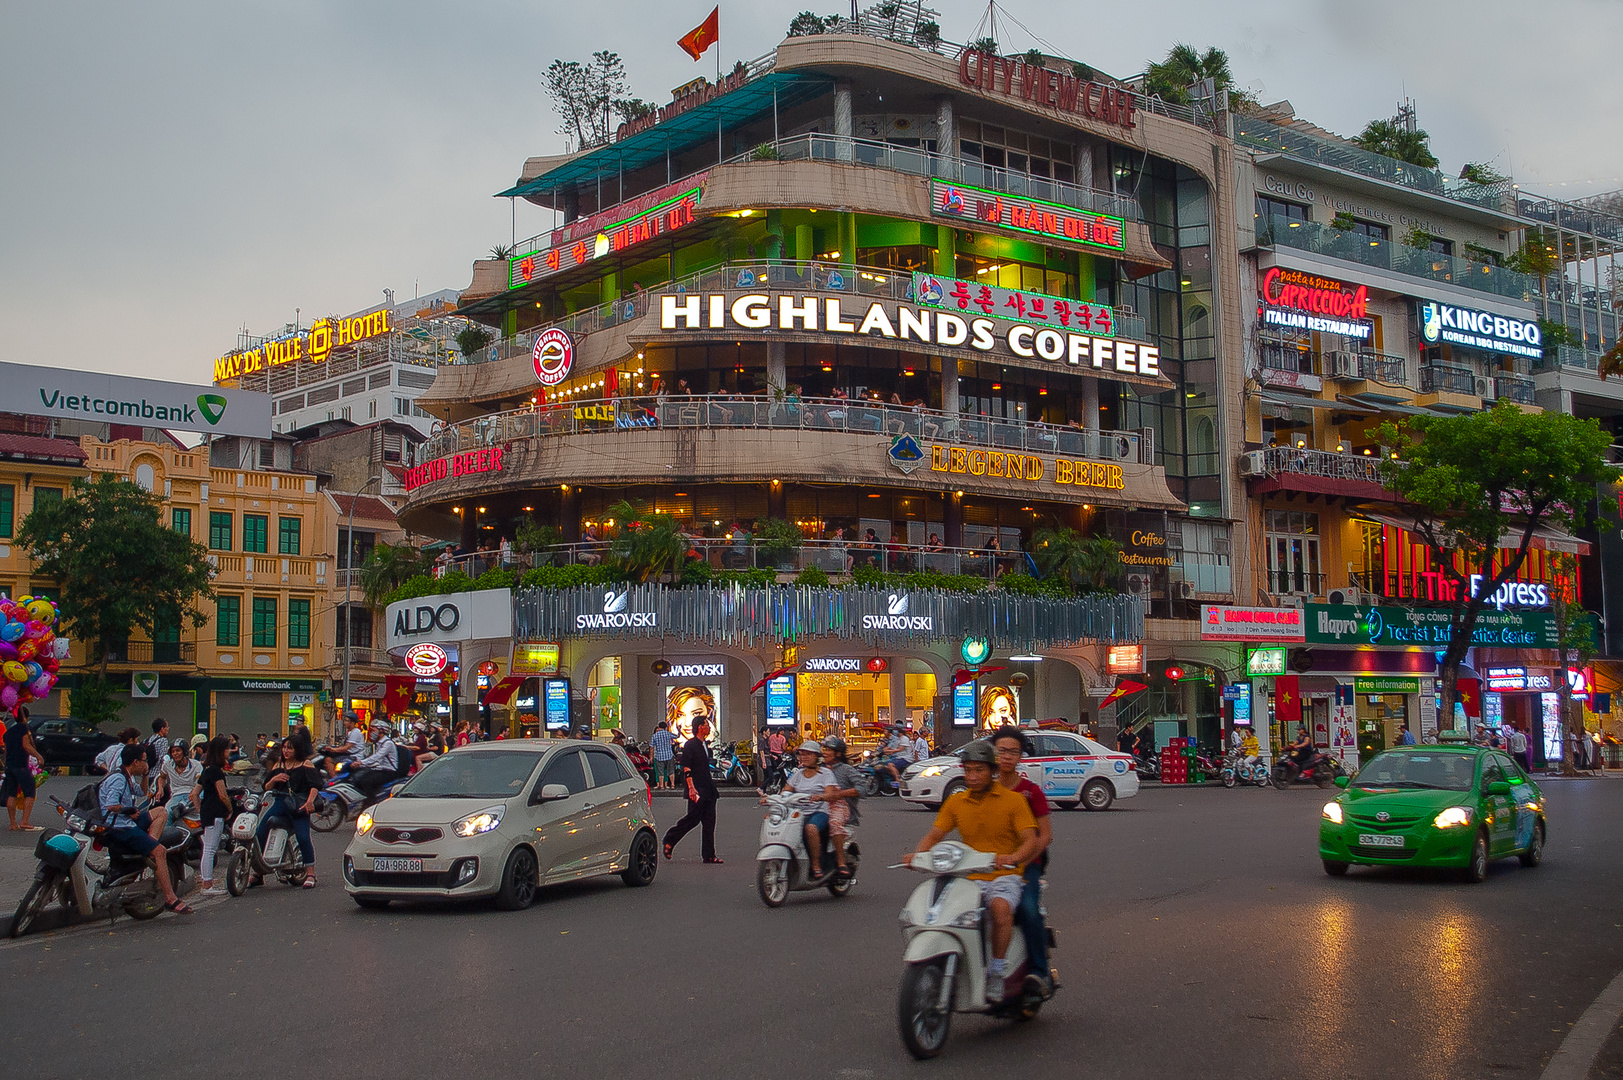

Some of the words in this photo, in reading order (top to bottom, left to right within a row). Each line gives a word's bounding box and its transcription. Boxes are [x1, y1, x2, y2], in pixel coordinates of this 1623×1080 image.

[960, 49, 1016, 95] CITY
[1021, 62, 1081, 113] VIEW
[1264, 174, 1292, 195] Cau
[1295, 182, 1315, 201] Go
[1322, 195, 1394, 223] Vietnamese
[1011, 204, 1057, 234] HÀN
[1063, 215, 1119, 246] QUỐC
[613, 225, 629, 251] MÌ
[1308, 277, 1315, 286] &
[1265, 309, 1307, 329] ITALIAN
[1307, 316, 1370, 339] RESTAURANT
[213, 354, 242, 382] MAY
[244, 348, 262, 374] DE
[264, 337, 302, 366] VILLE
[338, 309, 389, 346] HOTEL
[661, 294, 997, 351] HIGHLANDS
[1007, 325, 1160, 377] COFFEE
[1442, 330, 1476, 346] KOREAN
[1476, 337, 1493, 349] BBQ
[1493, 340, 1543, 358] RESTAURANT
[534, 333, 570, 359] HIGHLANDS
[539, 366, 568, 383] COFFEE
[39, 387, 197, 425] Vietcombank
[404, 457, 447, 492] LEGEND
[452, 447, 503, 477] BEER
[931, 444, 1044, 481] LEGEND
[1055, 458, 1125, 490] BEER
[1131, 530, 1166, 547] Coffee
[1118, 550, 1175, 566] Restaurant
[394, 602, 461, 637] ALDO
[576, 611, 658, 629] SWAROVSKI
[862, 614, 933, 631] SWAROVSKI
[1317, 611, 1358, 639] Hapro
[1426, 610, 1449, 622] CÔNG
[1386, 623, 1430, 642] Tourist
[1501, 627, 1538, 645] Center
[408, 644, 445, 660] HIGHLANDS
[411, 665, 441, 675] COFFEE
[661, 664, 725, 677] WAROVSKI
[805, 658, 861, 671] SWAROVSKI
[242, 680, 291, 689] Vietcombank
[1358, 680, 1375, 689] Free
[1375, 679, 1416, 690] information
[292, 694, 311, 702] ATM
[1053, 767, 1085, 775] DAIKIN
[375, 859, 420, 871] 29A-968.88
